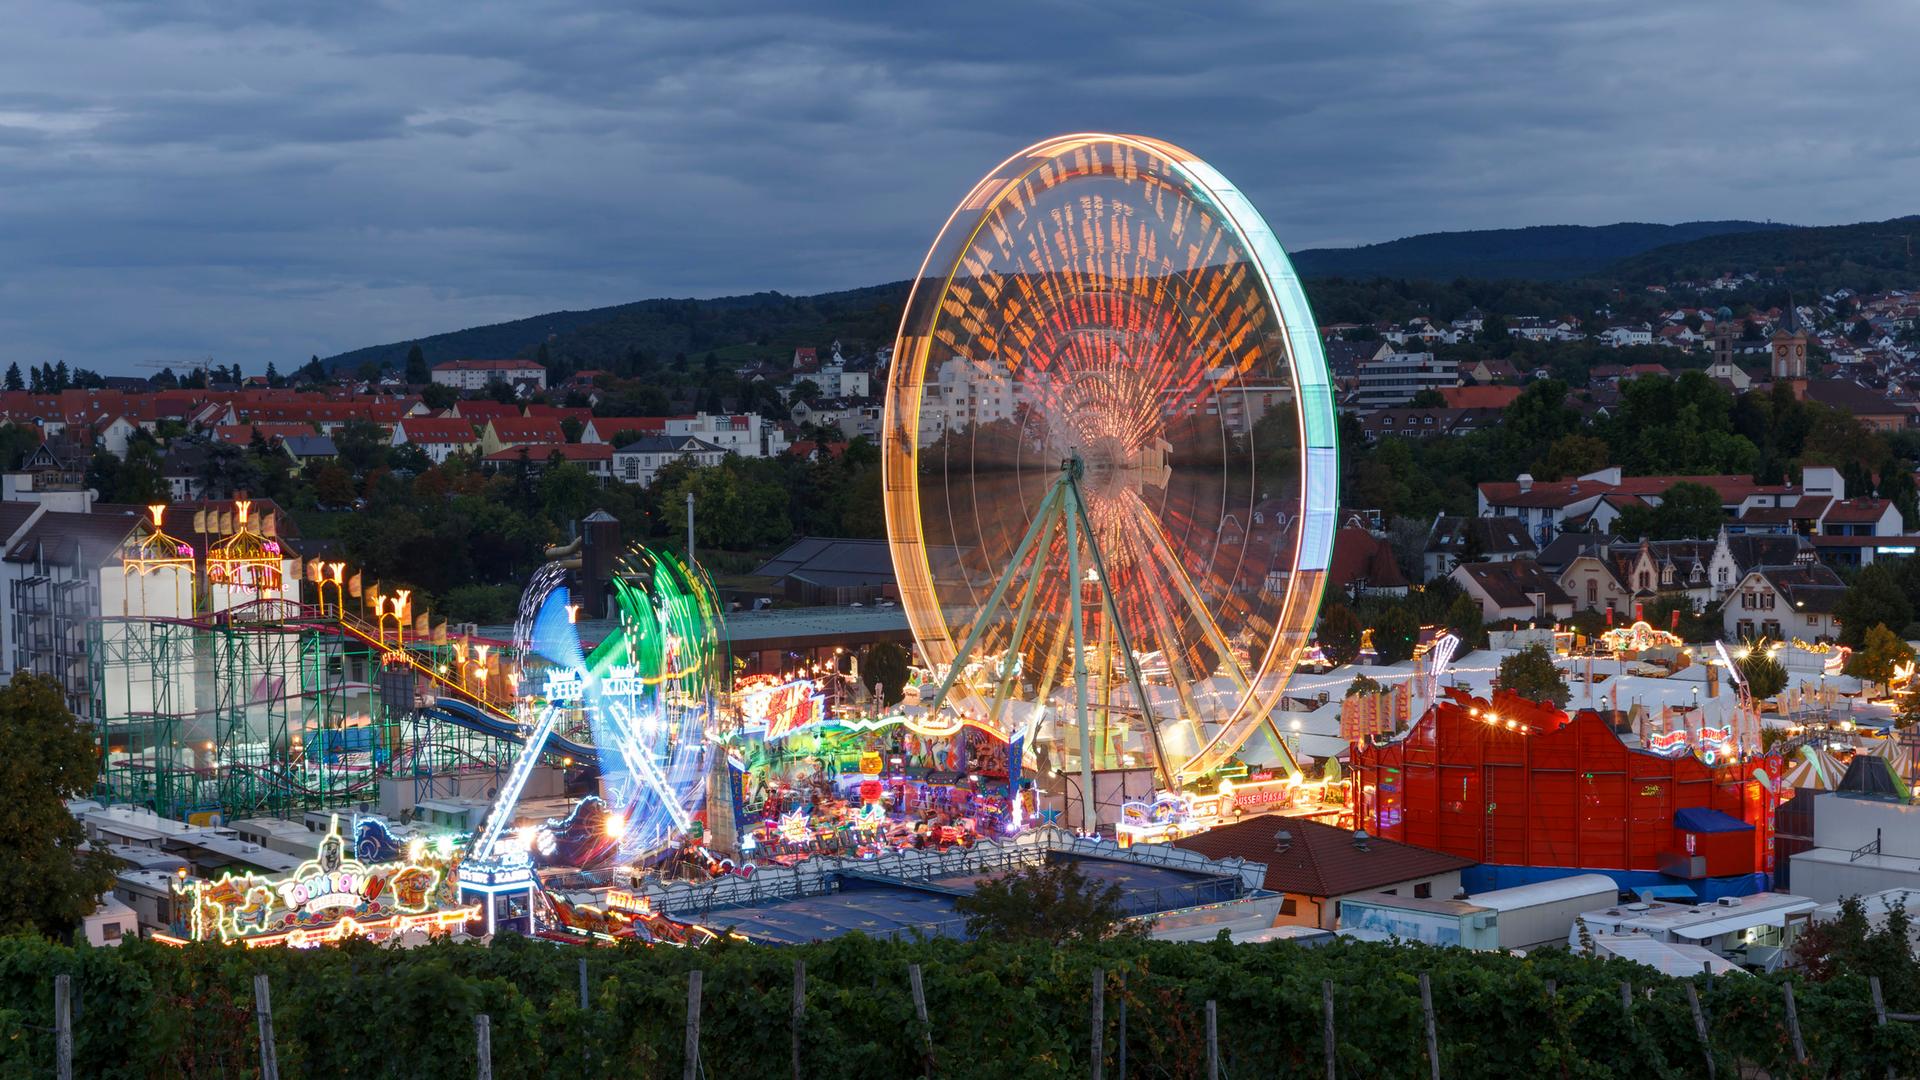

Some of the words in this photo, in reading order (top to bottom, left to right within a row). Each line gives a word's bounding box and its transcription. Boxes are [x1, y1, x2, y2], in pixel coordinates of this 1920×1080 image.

[543, 680, 583, 701] THE
[601, 678, 643, 696] KING
[277, 871, 386, 910] TOONTOWN
